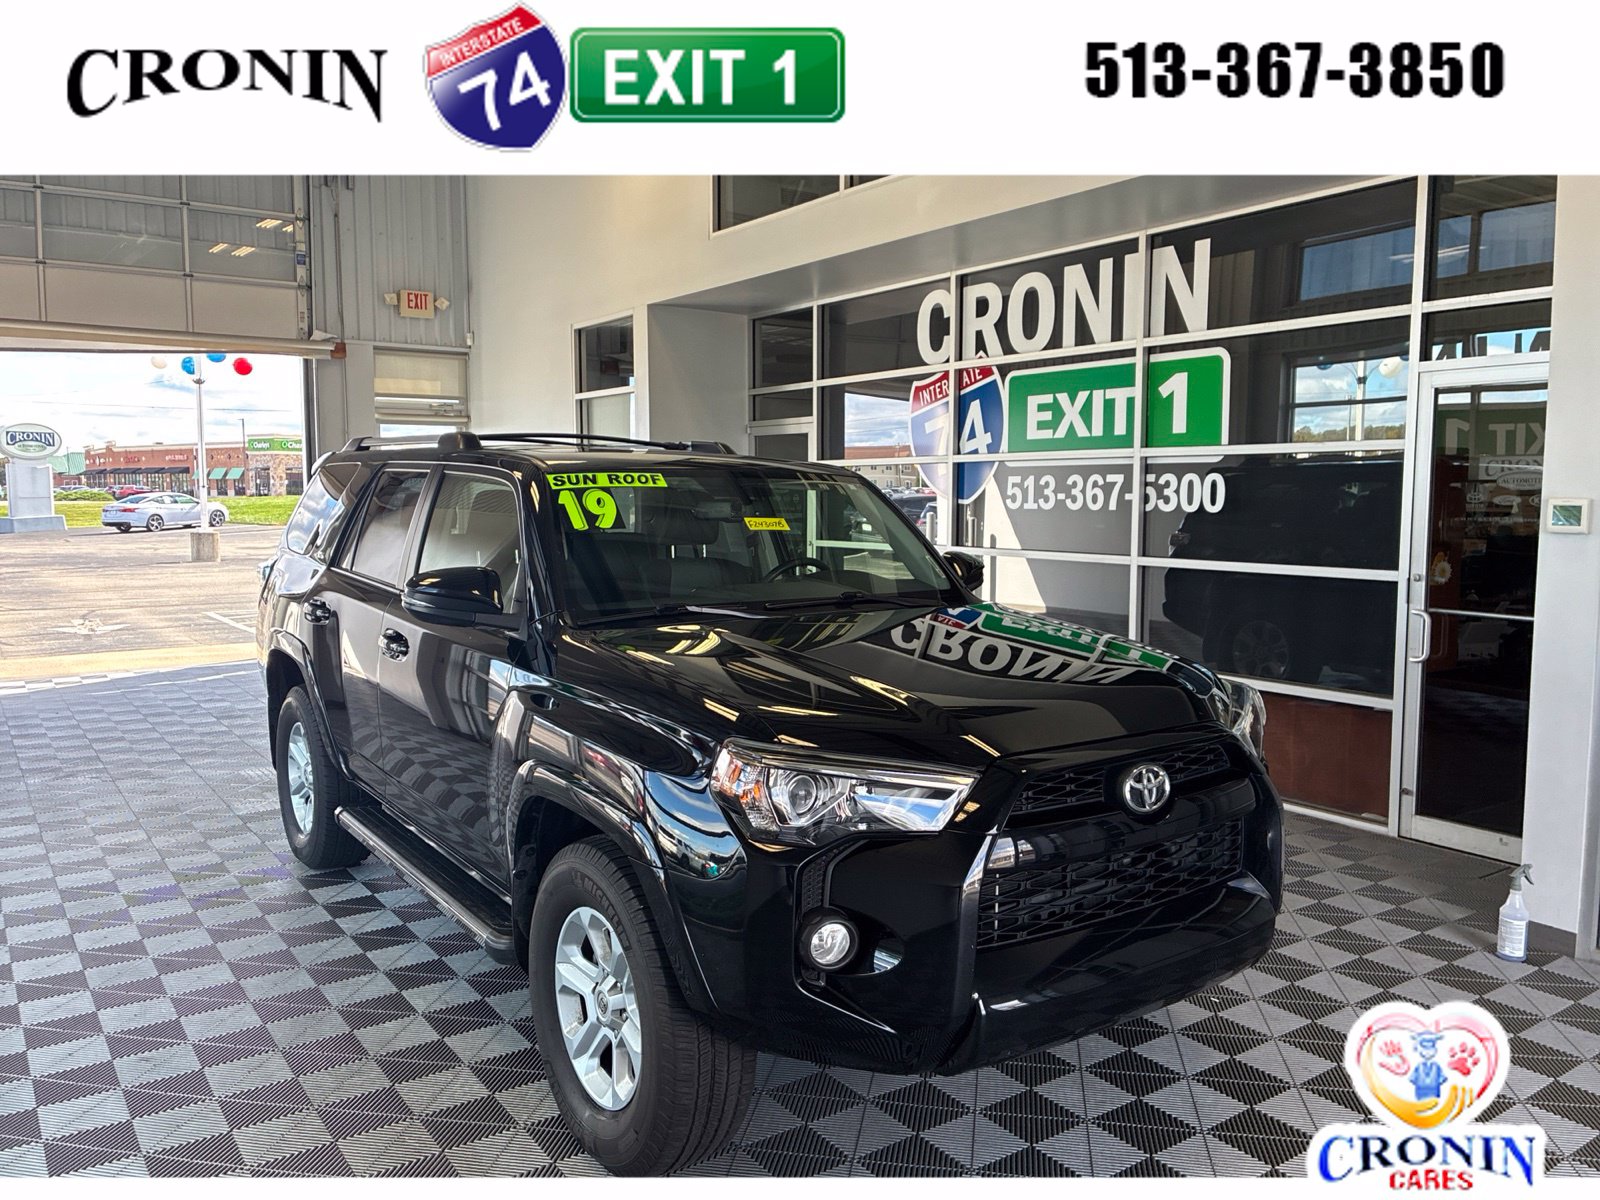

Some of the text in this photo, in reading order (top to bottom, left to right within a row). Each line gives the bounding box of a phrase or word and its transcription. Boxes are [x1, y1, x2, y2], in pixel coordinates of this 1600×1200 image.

[407, 292, 429, 310] EXIT
[916, 238, 1211, 365] CRONIN
[919, 366, 983, 406] INTERATE
[1026, 371, 1189, 440] EXIT 1
[7, 431, 54, 446] CRONIN
[924, 399, 993, 476] 74
[552, 473, 661, 487] SUN ROOF
[1004, 472, 1226, 514] 513-367-5300
[558, 488, 617, 531] 19
